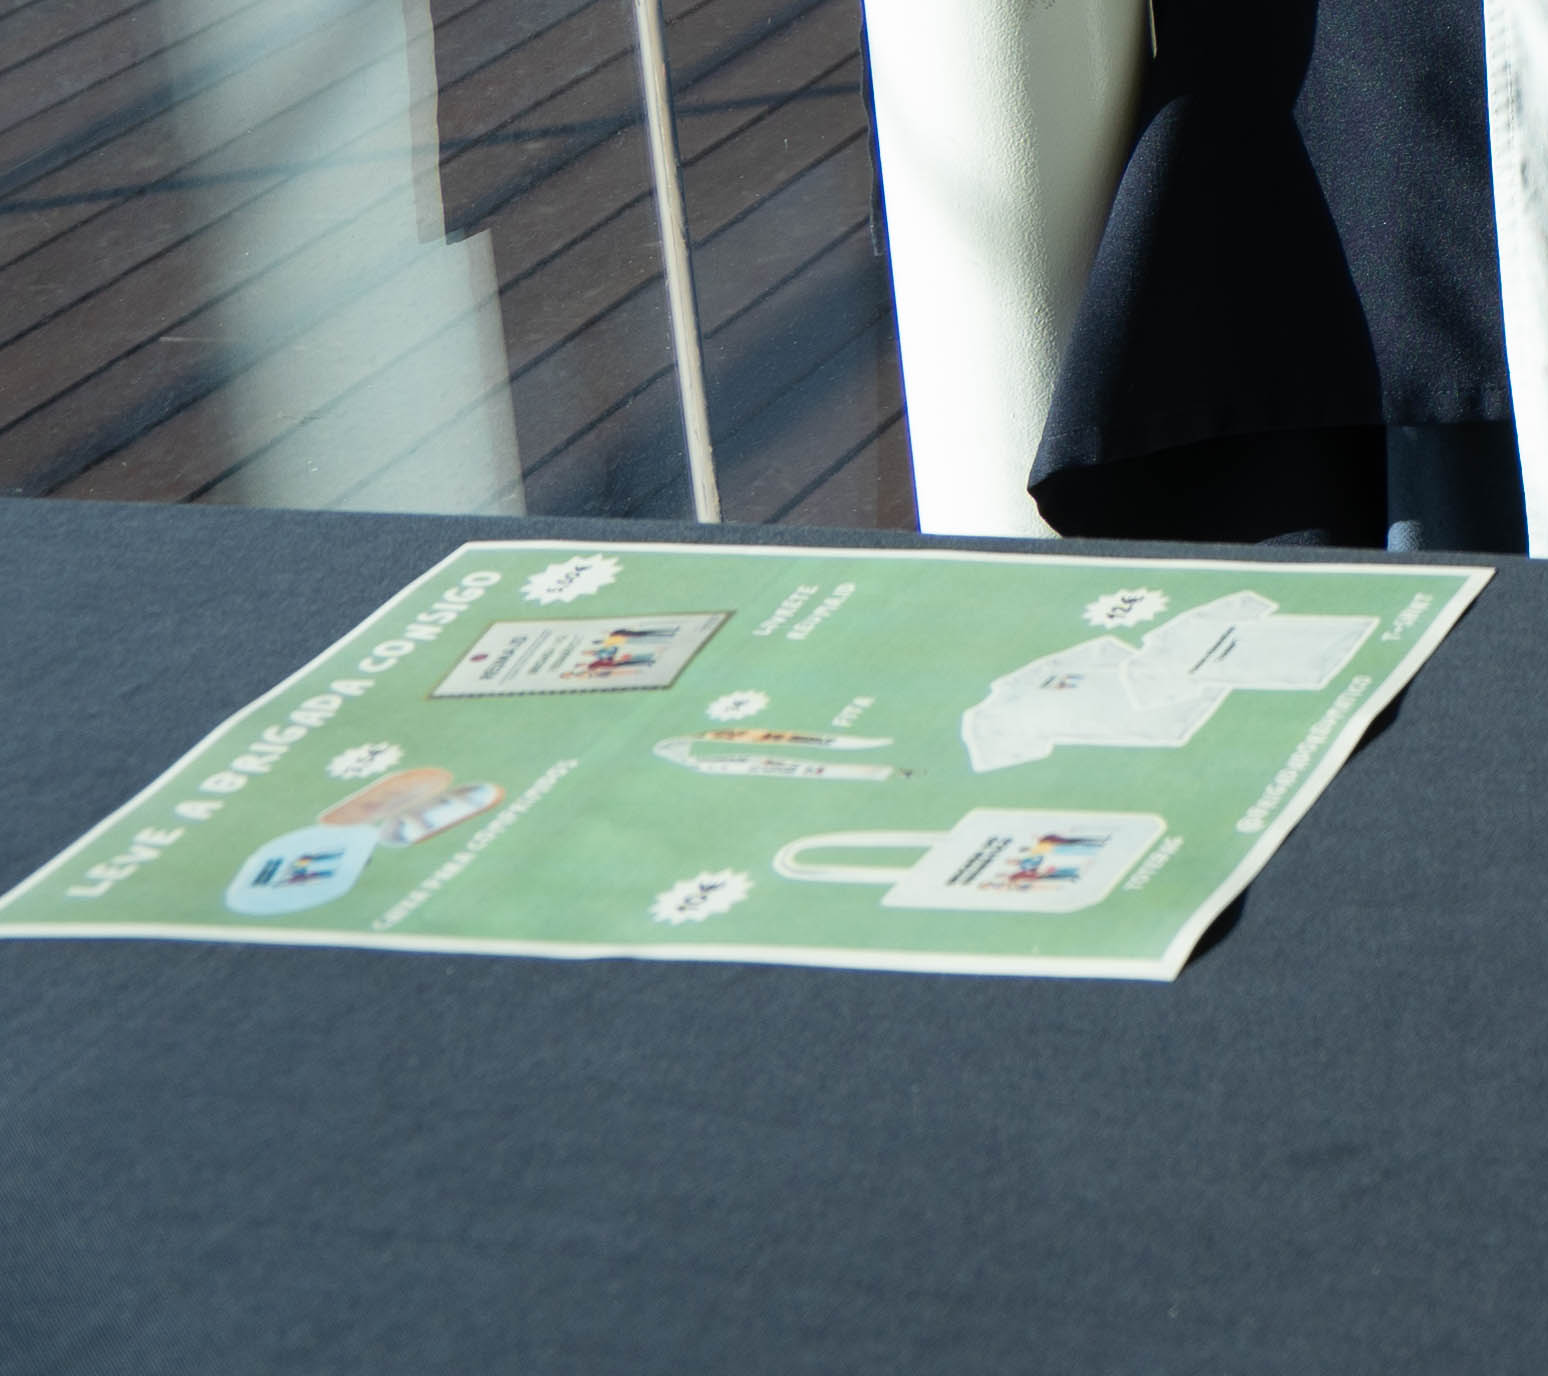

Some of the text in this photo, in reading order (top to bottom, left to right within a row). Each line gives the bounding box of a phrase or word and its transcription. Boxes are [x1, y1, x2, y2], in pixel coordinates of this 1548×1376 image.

[358, 570, 502, 675] CONSIGO
[199, 678, 376, 794] BRIGADA
[175, 800, 225, 821] A
[66, 825, 186, 900] LEVE
